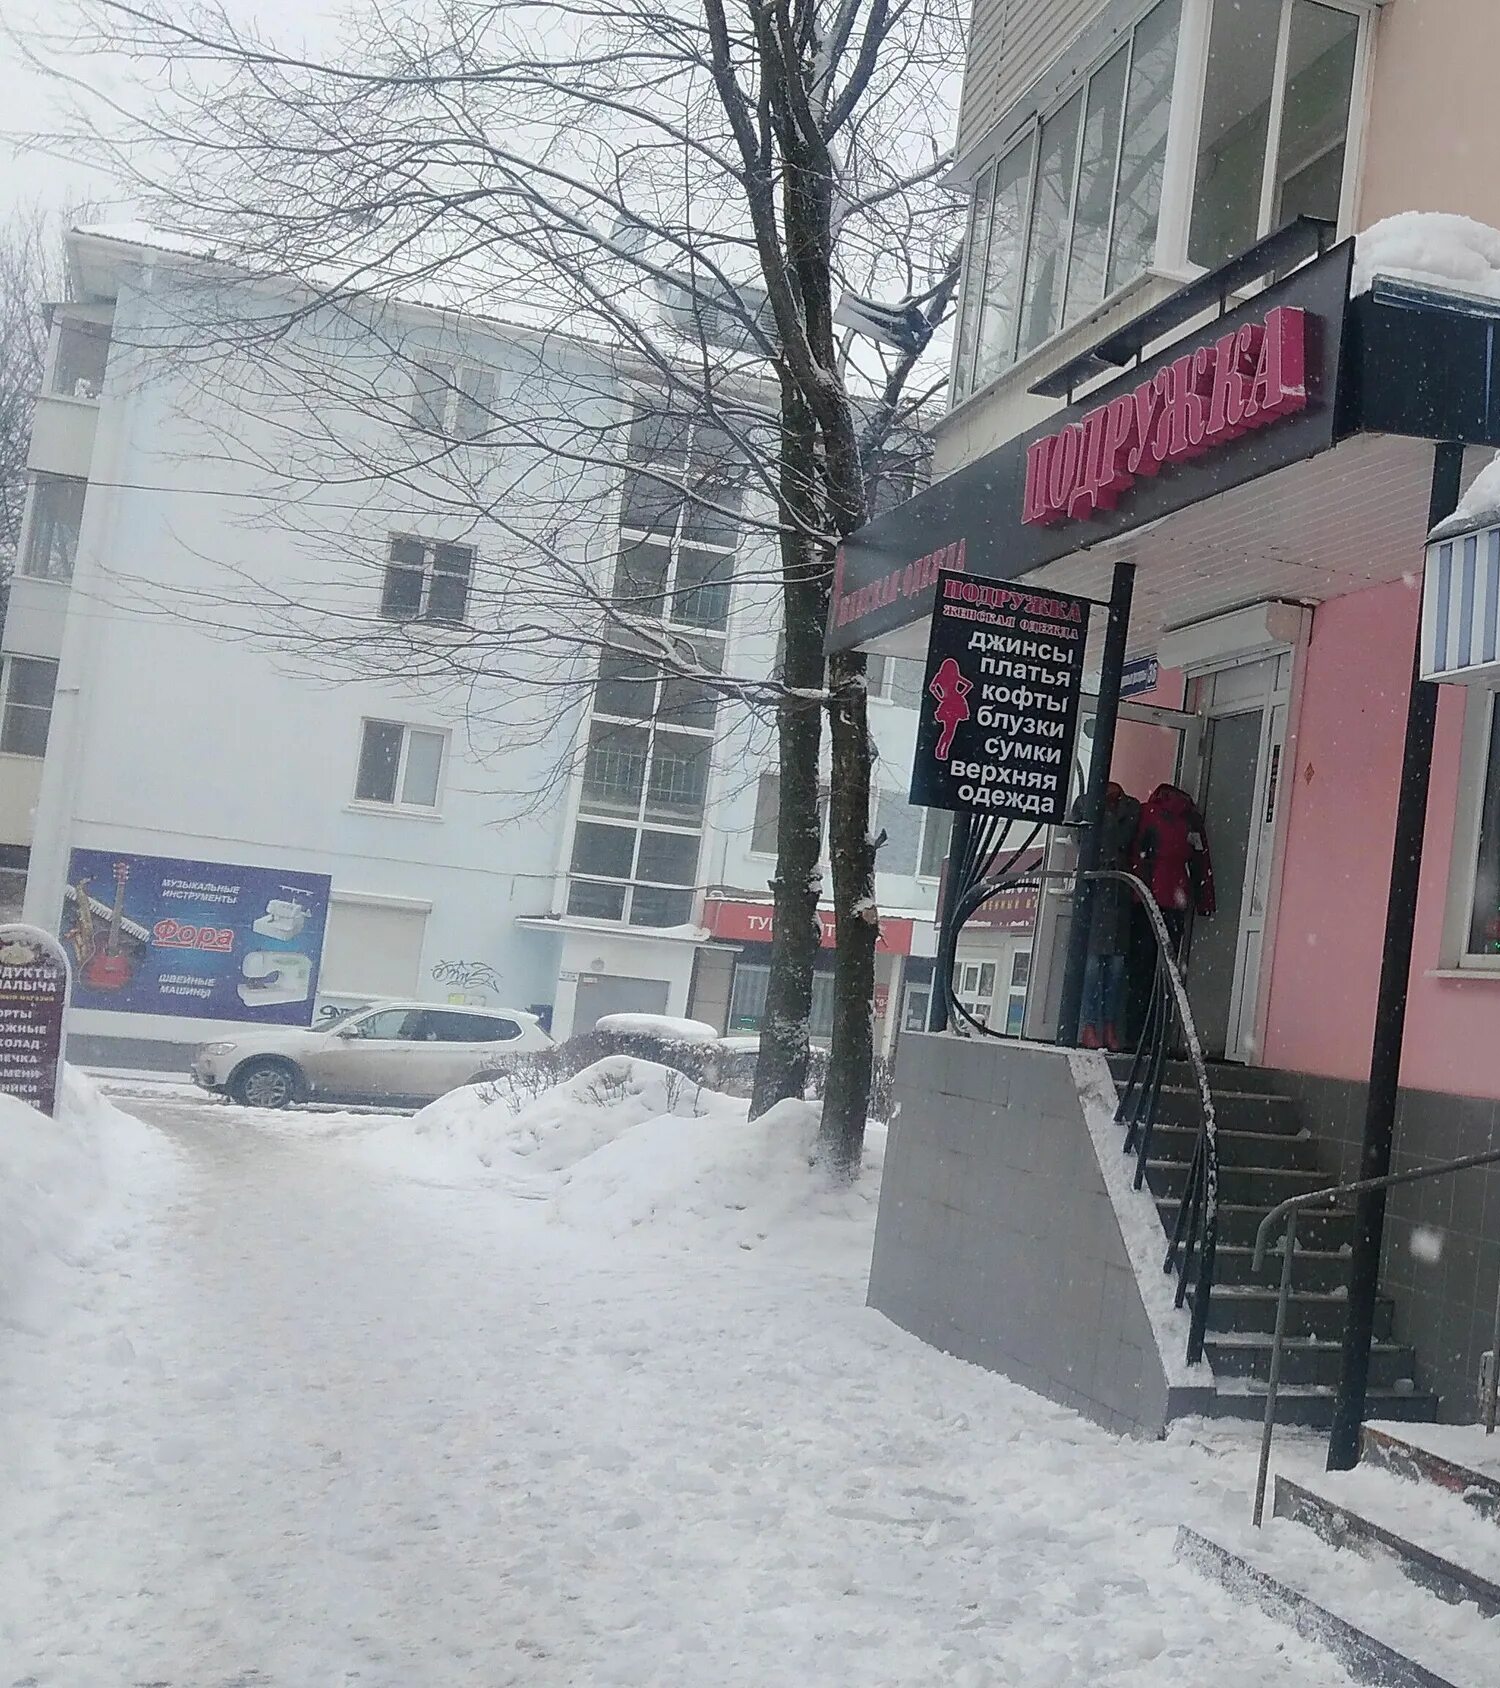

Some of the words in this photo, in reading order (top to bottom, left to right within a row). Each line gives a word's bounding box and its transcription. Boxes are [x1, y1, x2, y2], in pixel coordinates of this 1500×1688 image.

[1021, 306, 1305, 526] ПОДРУЖКА
[943, 579, 1081, 623] ПОДРУЖКА
[943, 604, 1016, 628] ЖЕНСКАЯ
[1019, 619, 1079, 640] ОДЕЖДА
[967, 631, 1074, 664] джинсы
[980, 657, 1071, 687] платья
[981, 684, 1068, 713] кофты
[977, 706, 1065, 739] блузки
[984, 737, 1062, 764] сумки
[950, 760, 1058, 791] верхняя
[957, 785, 1055, 815] одежда
[162, 878, 240, 894] МУЗЫКАЛЬНЫЕ
[162, 889, 237, 904] ИНСТРУМЕНТЫ
[152, 918, 234, 952] Фора
[0, 967, 57, 979] ДУКТЫ
[159, 974, 216, 987] ШВЕЙНЫЕ
[159, 985, 211, 999] МАШИНЫ
